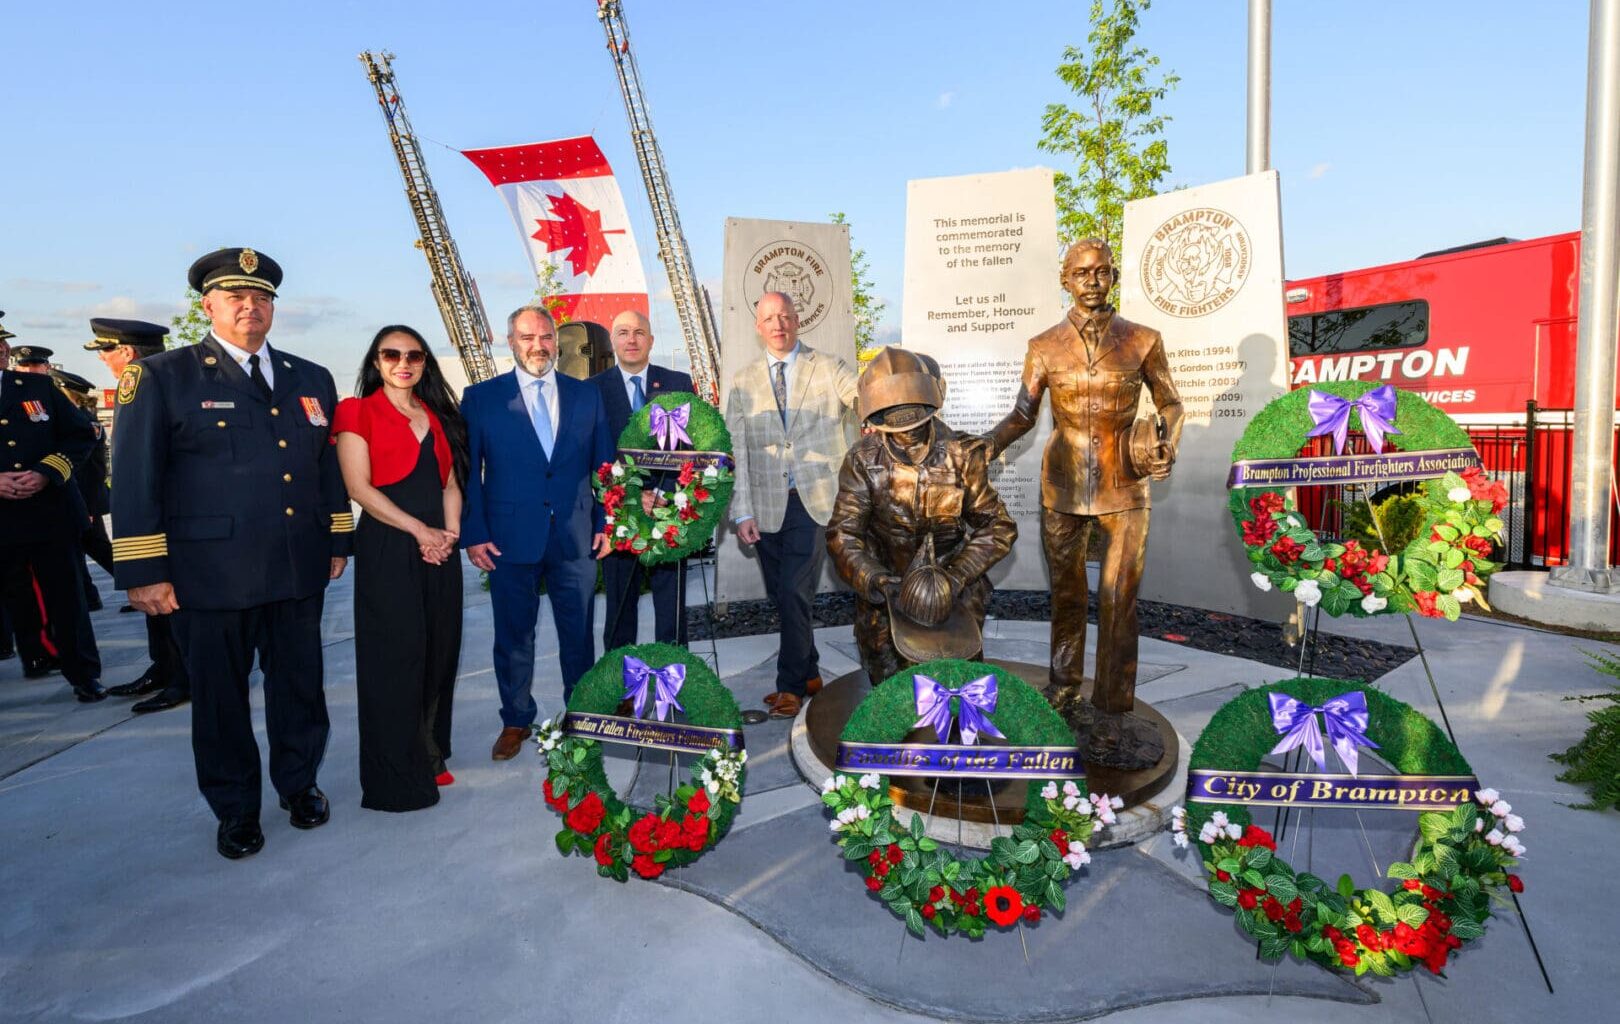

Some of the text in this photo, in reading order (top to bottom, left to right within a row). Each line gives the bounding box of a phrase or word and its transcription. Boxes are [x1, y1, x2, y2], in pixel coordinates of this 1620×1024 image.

[934, 212, 1026, 228] This memorial is
[1155, 211, 1234, 242] BRAMPTON
[936, 227, 1023, 242] commemorated
[939, 242, 1020, 255] to the memory
[754, 247, 824, 277] BRAMPTON FIRE
[946, 256, 1012, 268] of the fallen
[1156, 256, 1164, 280] LOCAL
[956, 293, 1006, 306] Let us all
[1154, 286, 1235, 316] FIRE FIGHTERS
[800, 302, 824, 328] ERVICES
[928, 307, 1035, 320] Remember, Honour
[948, 321, 1014, 333] and Support
[1178, 349, 1200, 358] Kitto
[1204, 346, 1234, 356] (1994)
[1180, 364, 1213, 373] Gordon
[1216, 361, 1248, 371] (1997)
[1290, 346, 1470, 384] AMPTON
[1174, 378, 1240, 388] Ritchie (2003)
[1213, 393, 1243, 402] (2009)
[1416, 389, 1476, 404] VICES
[1215, 408, 1246, 418] (2015)
[1243, 452, 1477, 484] Brampton Professional Firefighters Association
[598, 720, 624, 736] Fallen
[844, 747, 1074, 772] Families of the Fallen
[1204, 776, 1470, 806] City of Brampton
